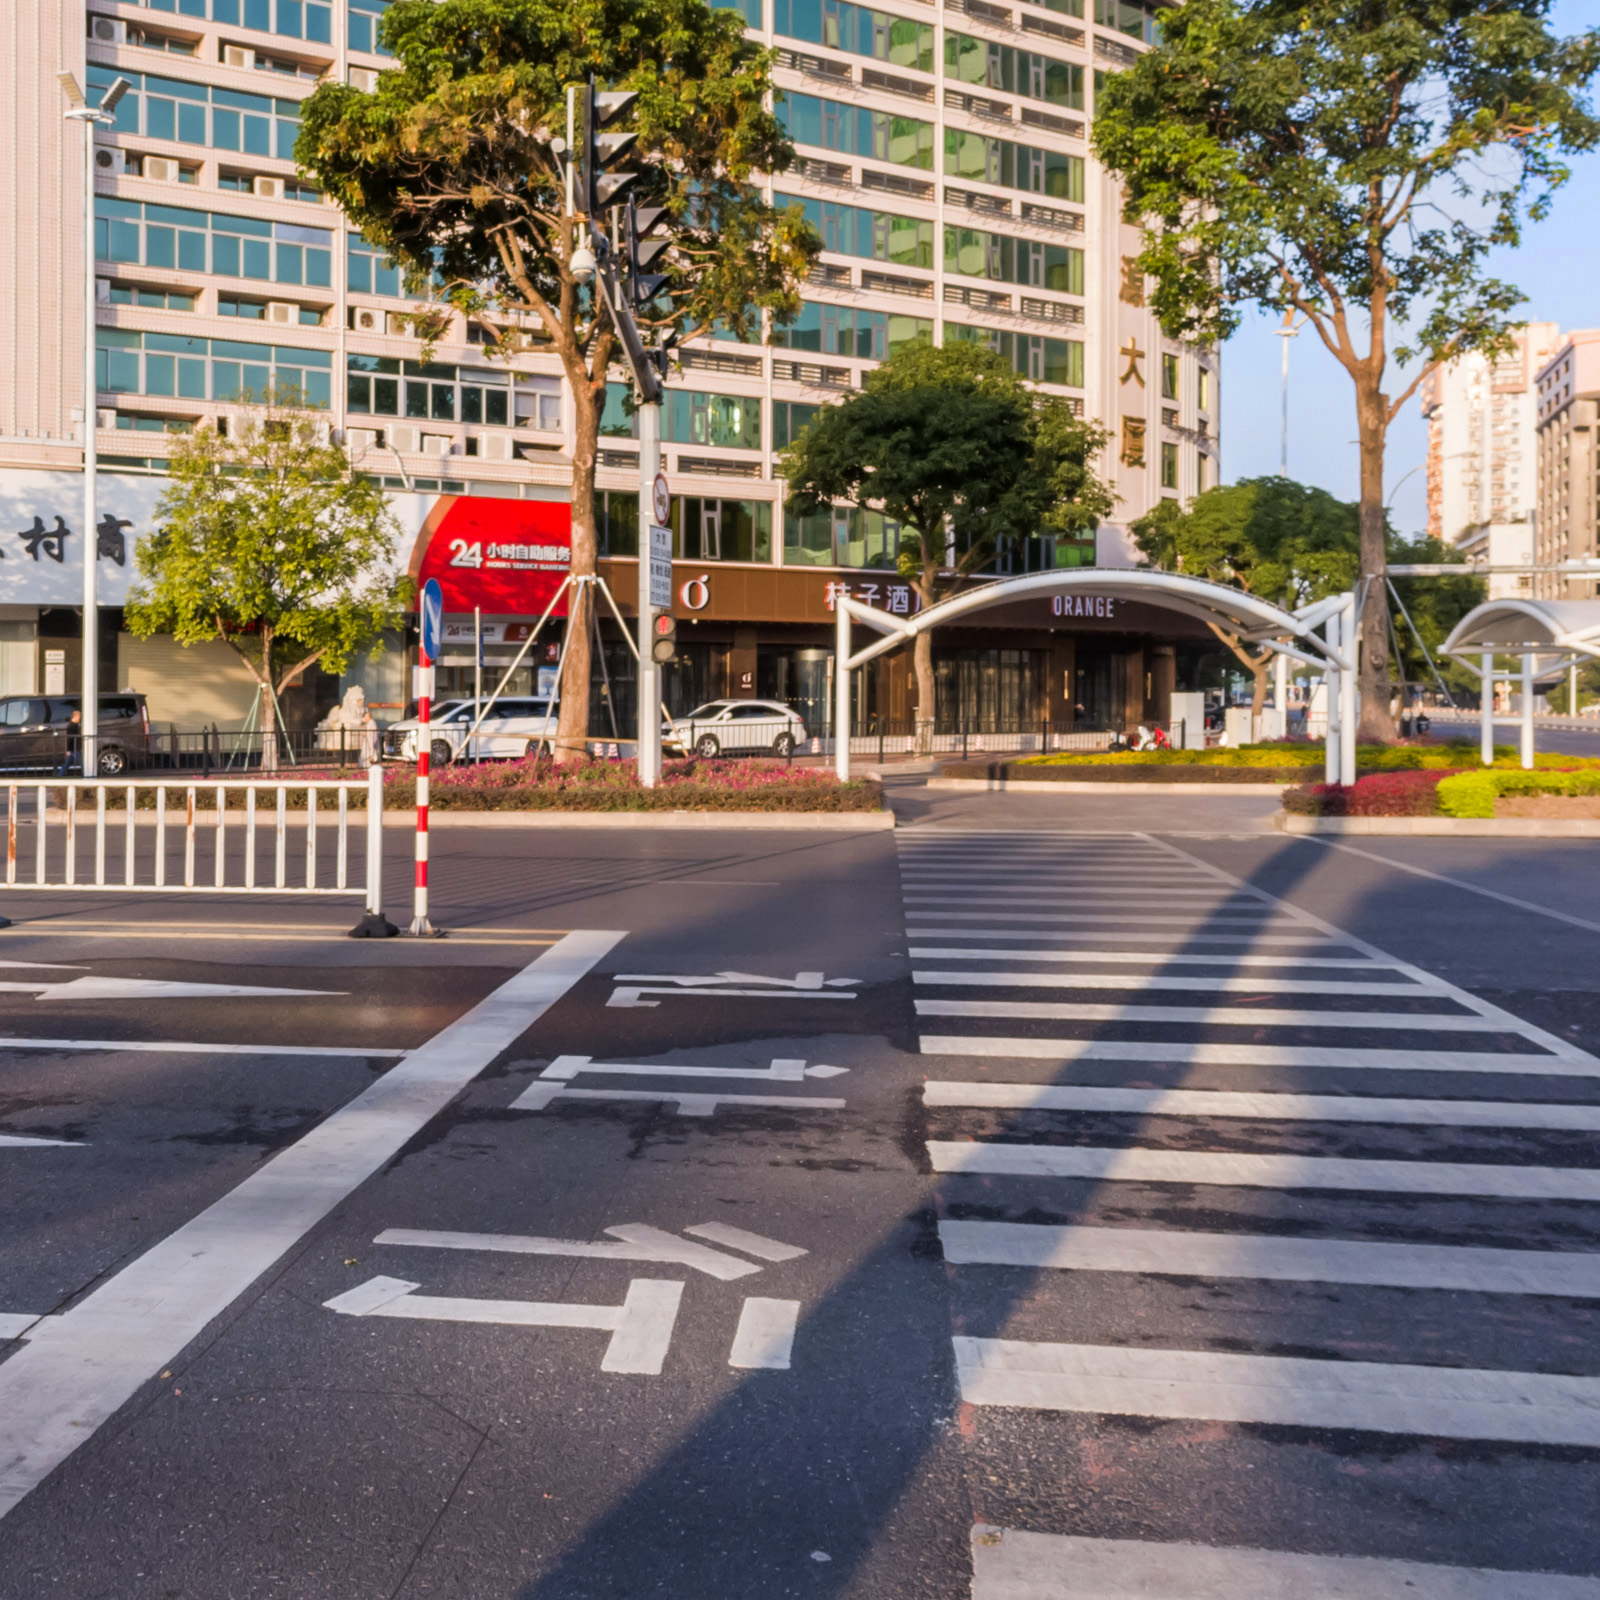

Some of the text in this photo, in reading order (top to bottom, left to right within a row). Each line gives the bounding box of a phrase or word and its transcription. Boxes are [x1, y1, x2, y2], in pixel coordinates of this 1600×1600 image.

[449, 538, 483, 569] 24
[824, 581, 922, 614] 桔子酒
[1052, 595, 1114, 618] ORANGE
